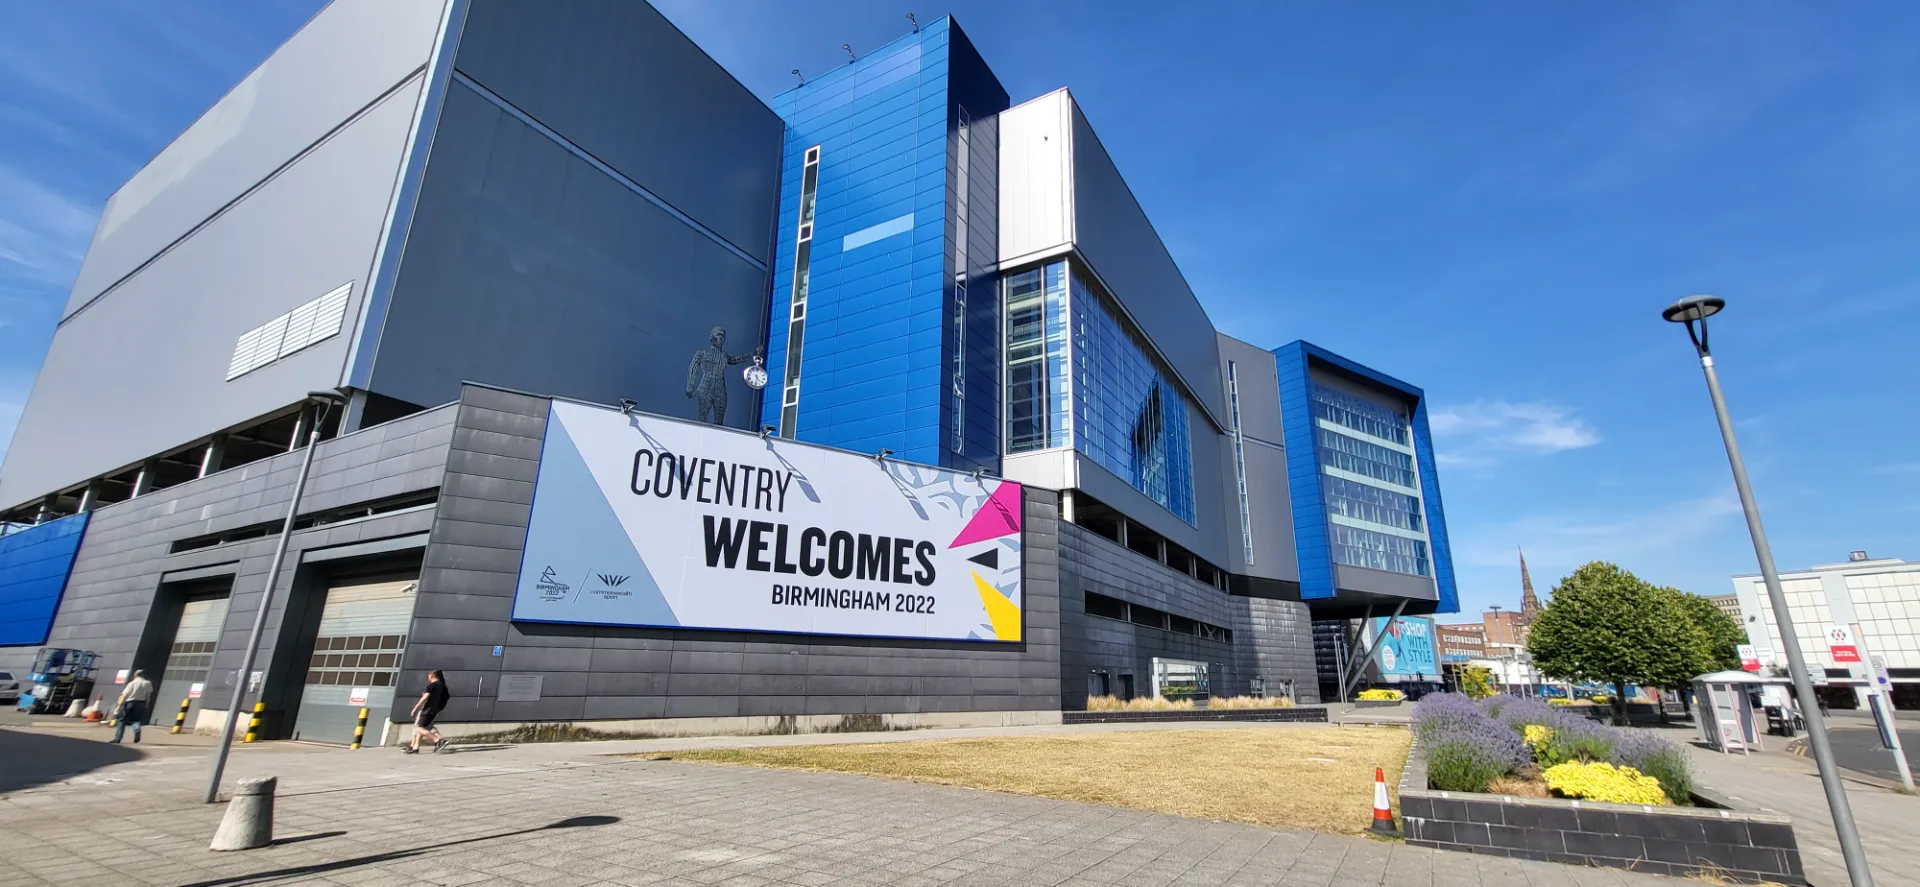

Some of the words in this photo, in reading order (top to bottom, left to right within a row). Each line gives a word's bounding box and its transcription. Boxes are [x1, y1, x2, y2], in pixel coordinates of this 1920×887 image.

[630, 448, 792, 512] COVENTRY
[703, 515, 936, 586] WELCOMES
[771, 584, 890, 612] BIRMINGHAM
[895, 593, 935, 614] 2022
[1405, 622, 1426, 636] SHOP
[1407, 636, 1428, 649] WITH
[1408, 649, 1432, 663] STYLE
